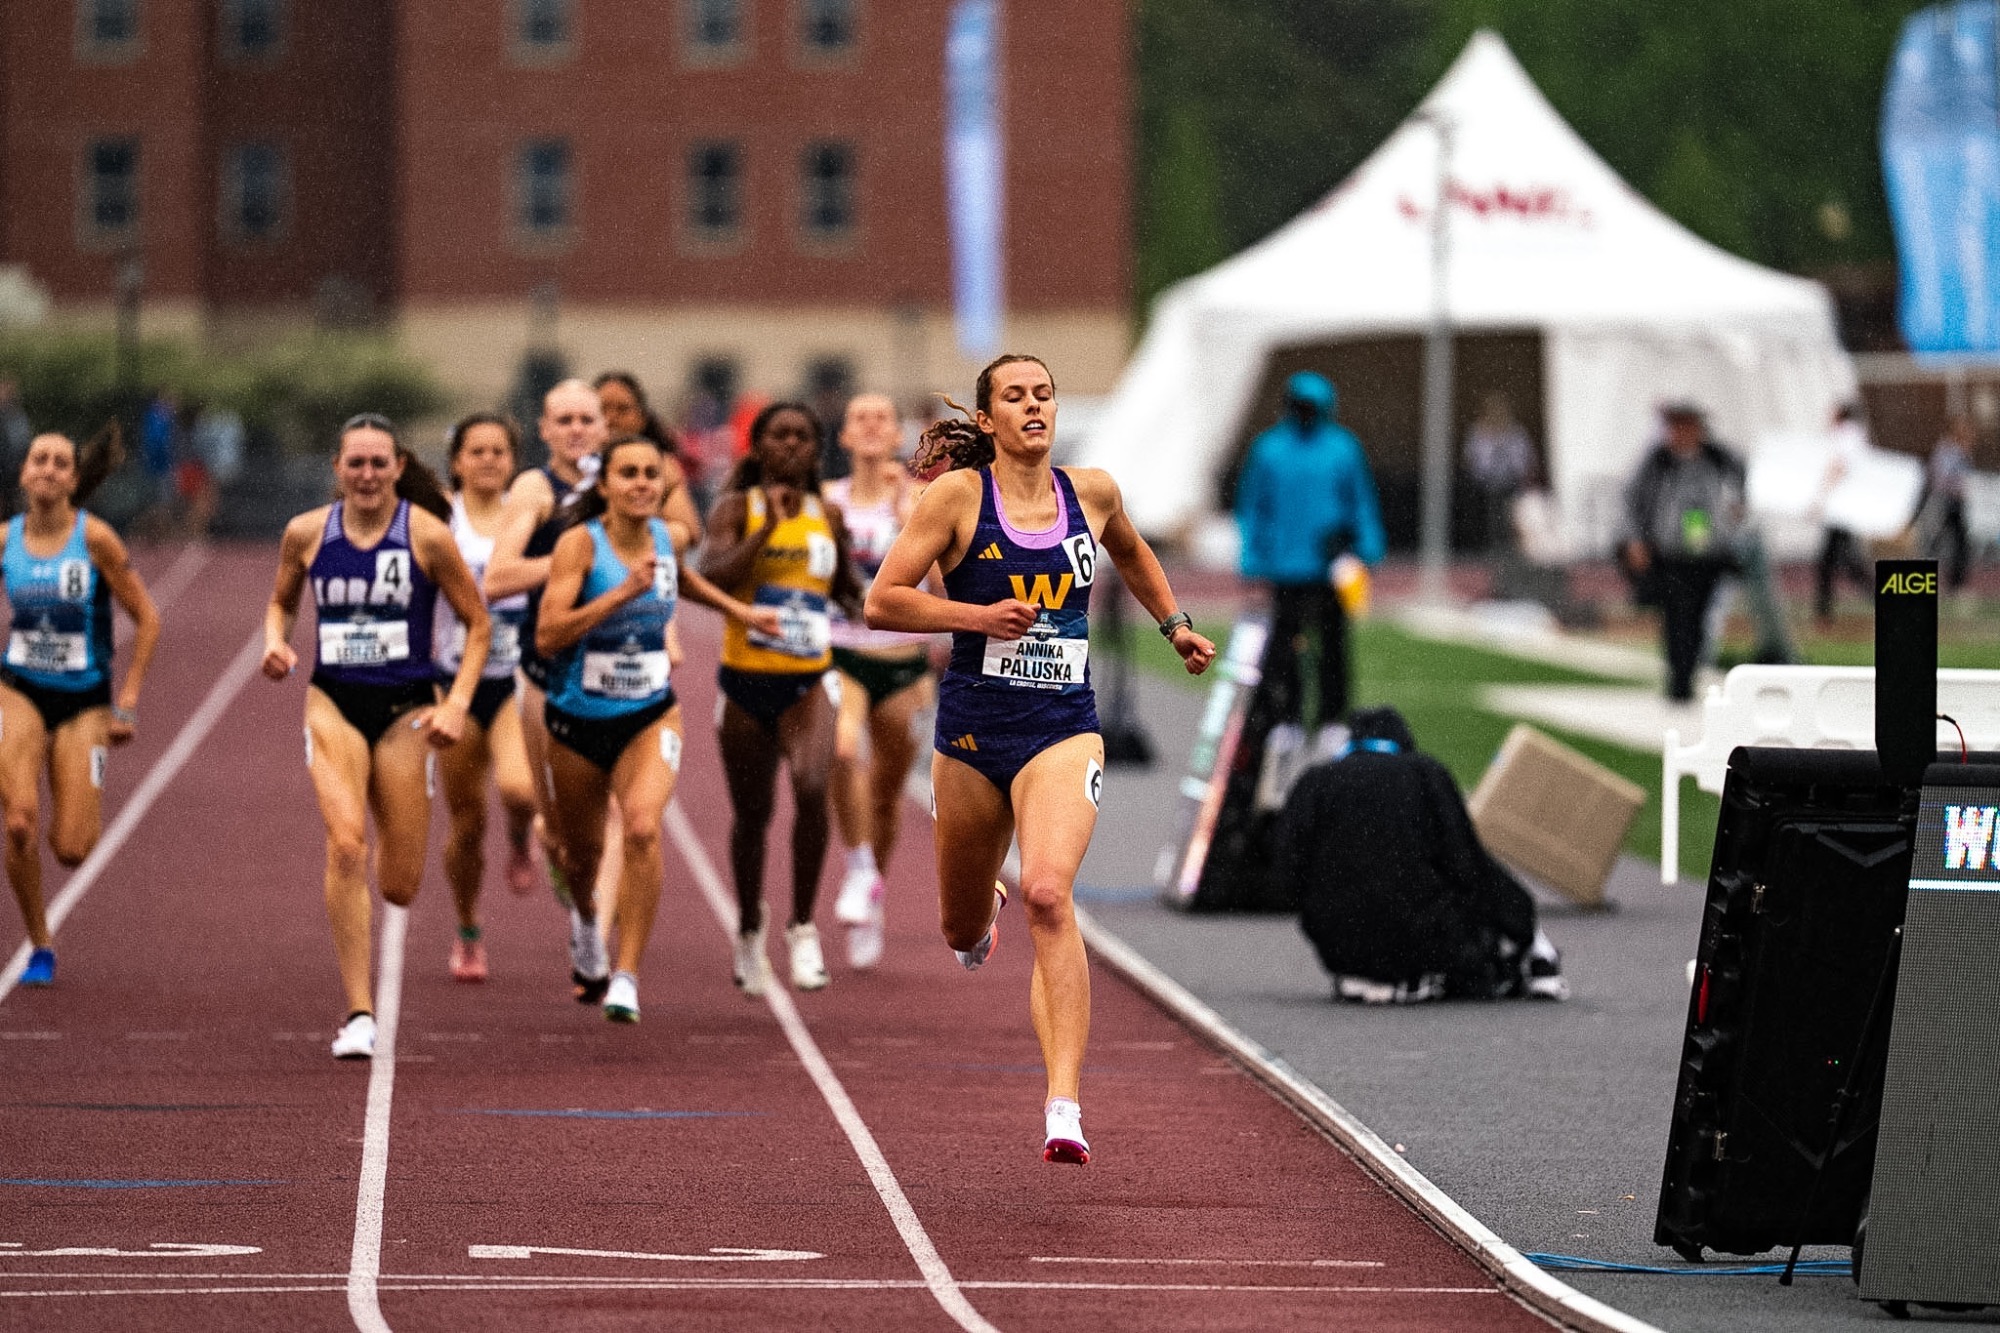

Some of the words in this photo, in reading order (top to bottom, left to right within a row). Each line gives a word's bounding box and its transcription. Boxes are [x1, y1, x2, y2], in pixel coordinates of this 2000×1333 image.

[384, 557, 401, 588] 4
[1074, 538, 1092, 583] 6
[66, 562, 82, 598] 8
[1008, 573, 1075, 610] W
[1881, 572, 1937, 594] ALGE
[1016, 642, 1064, 659] ANNIKA
[1000, 657, 1072, 681] PALUSKA
[1944, 805, 2000, 870] W
